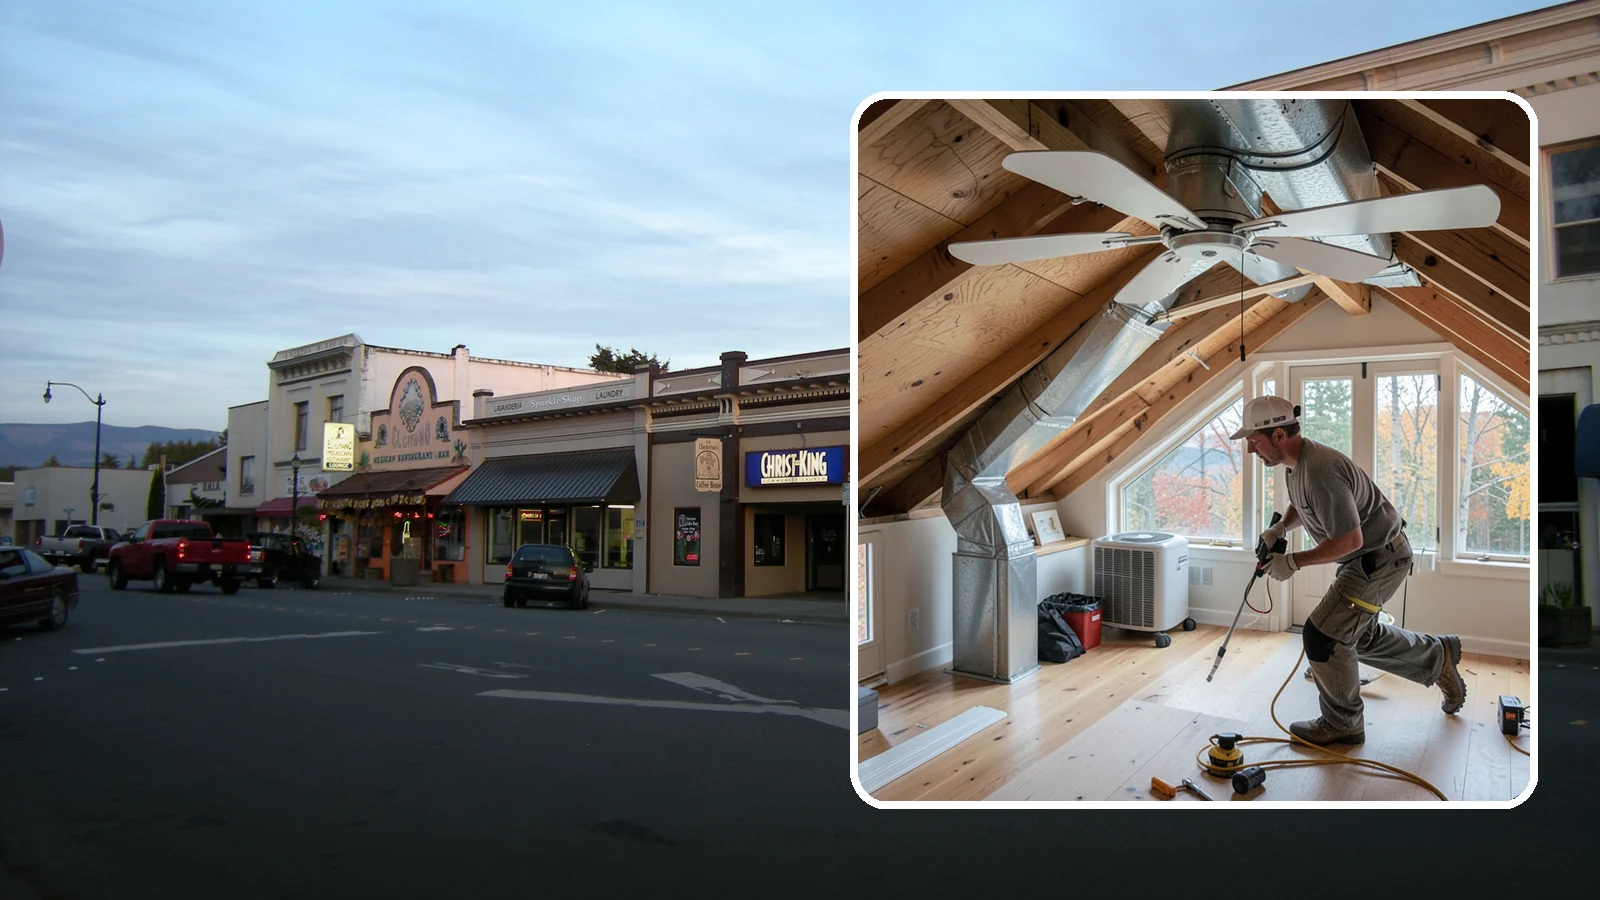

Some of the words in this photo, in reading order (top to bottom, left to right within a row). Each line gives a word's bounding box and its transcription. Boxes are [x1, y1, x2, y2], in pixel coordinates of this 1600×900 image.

[595, 389, 623, 400] LAUNDRY
[493, 402, 523, 413] LAVANDERIA
[531, 399, 560, 409] Sparkle
[561, 395, 582, 405] Shop
[374, 455, 396, 464] MEXICAN
[397, 451, 434, 462] RESTAURANT
[438, 450, 450, 459] BAR
[761, 452, 797, 478] CHRIST
[799, 450, 827, 476] KING
[697, 481, 709, 489] Coffee
